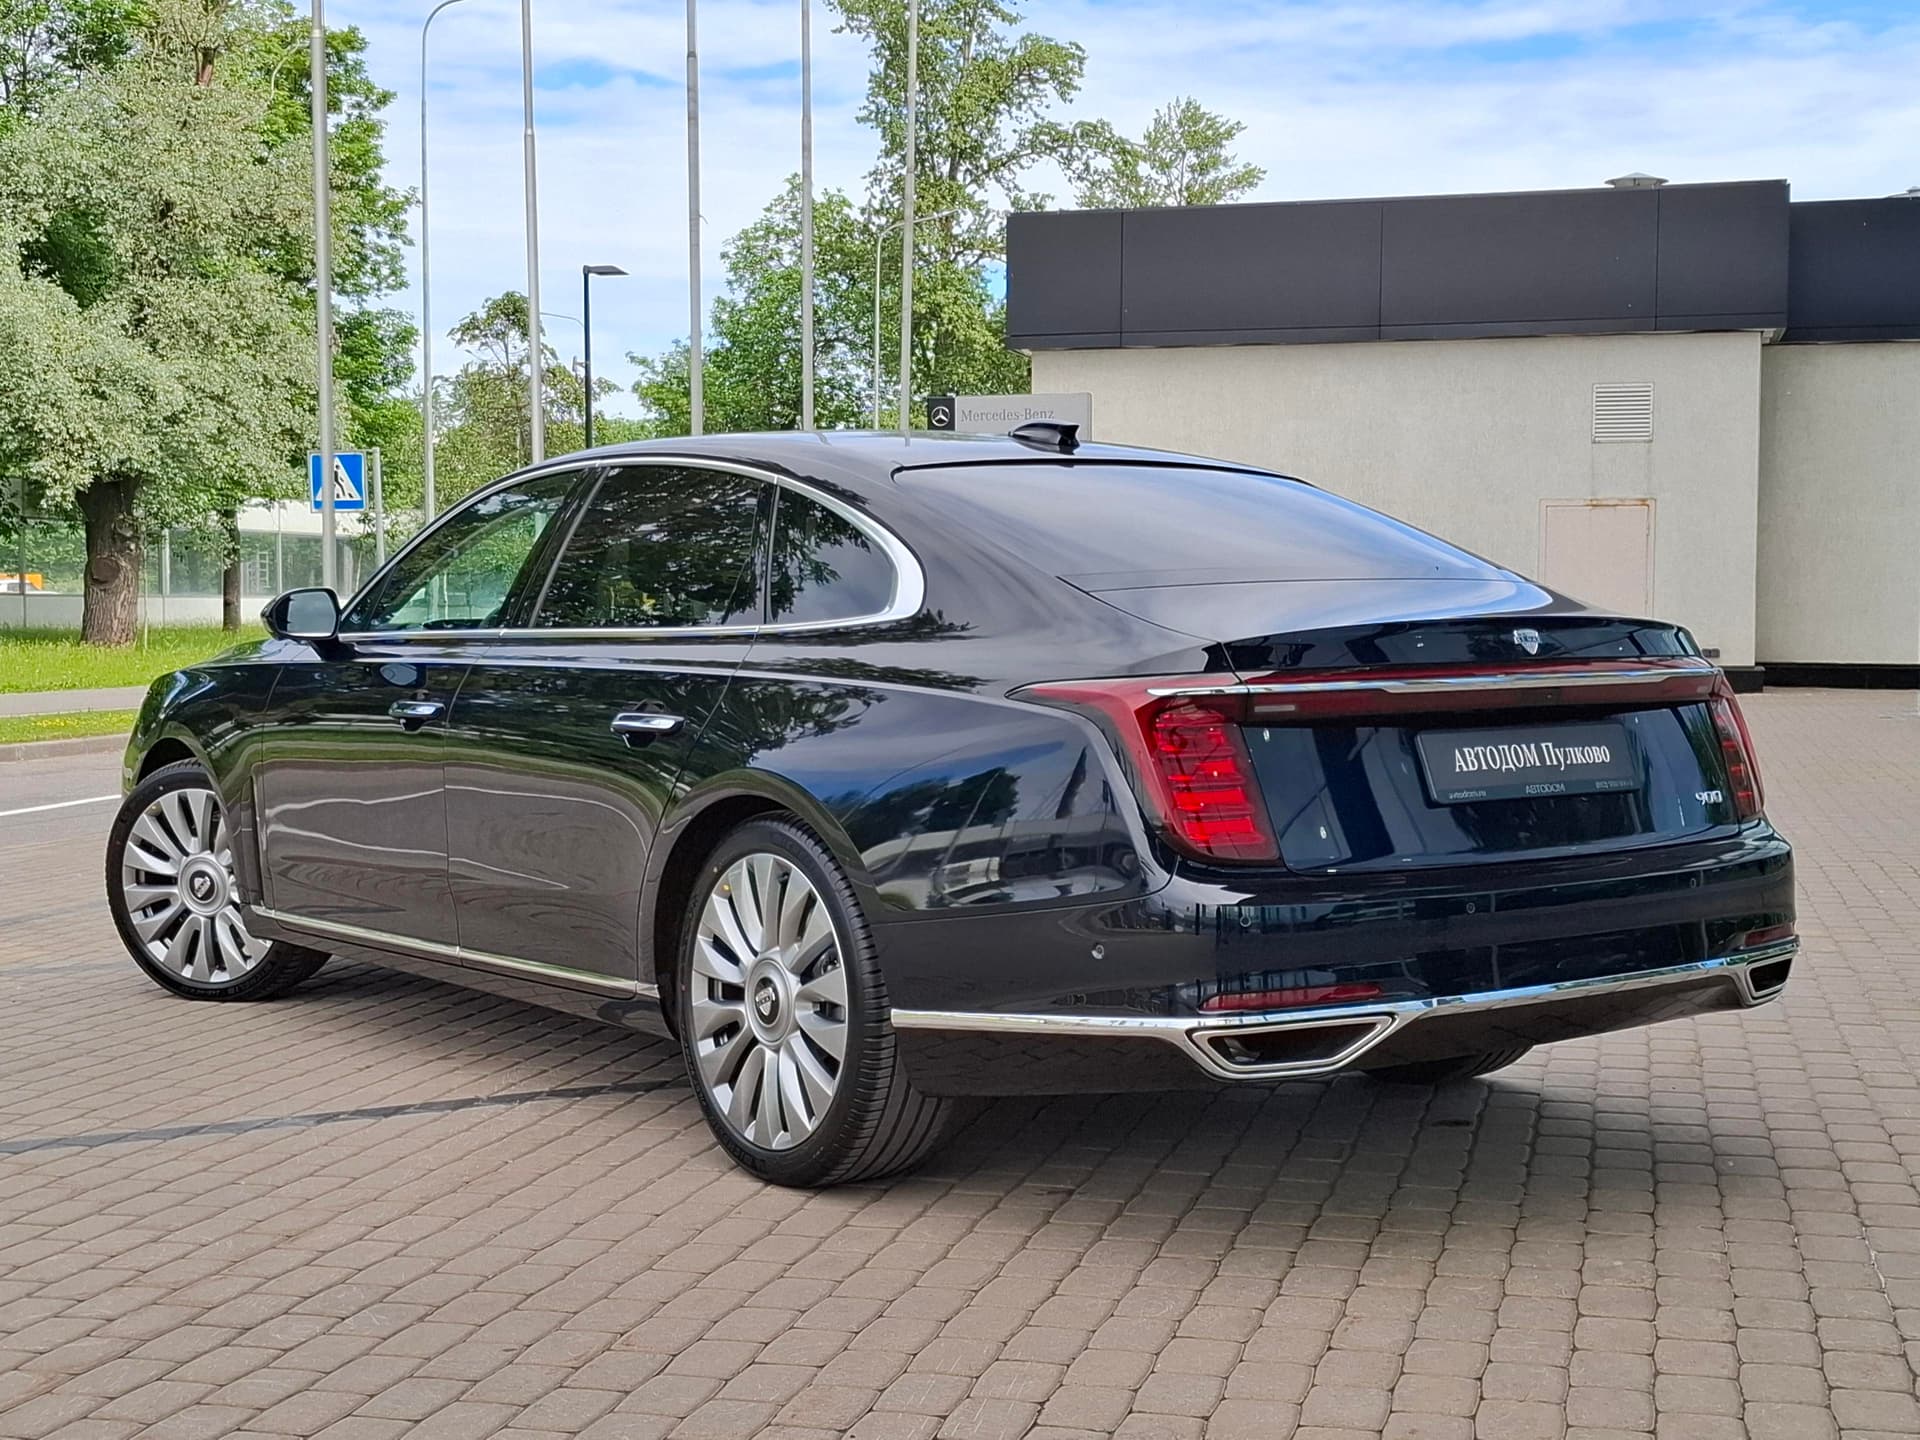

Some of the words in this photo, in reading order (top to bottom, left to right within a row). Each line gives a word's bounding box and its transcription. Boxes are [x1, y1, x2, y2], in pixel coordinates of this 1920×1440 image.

[961, 408, 1055, 422] Mercedes-Benz
[1455, 743, 1541, 773] АВТОДОМ
[1541, 742, 1610, 771] Пулково
